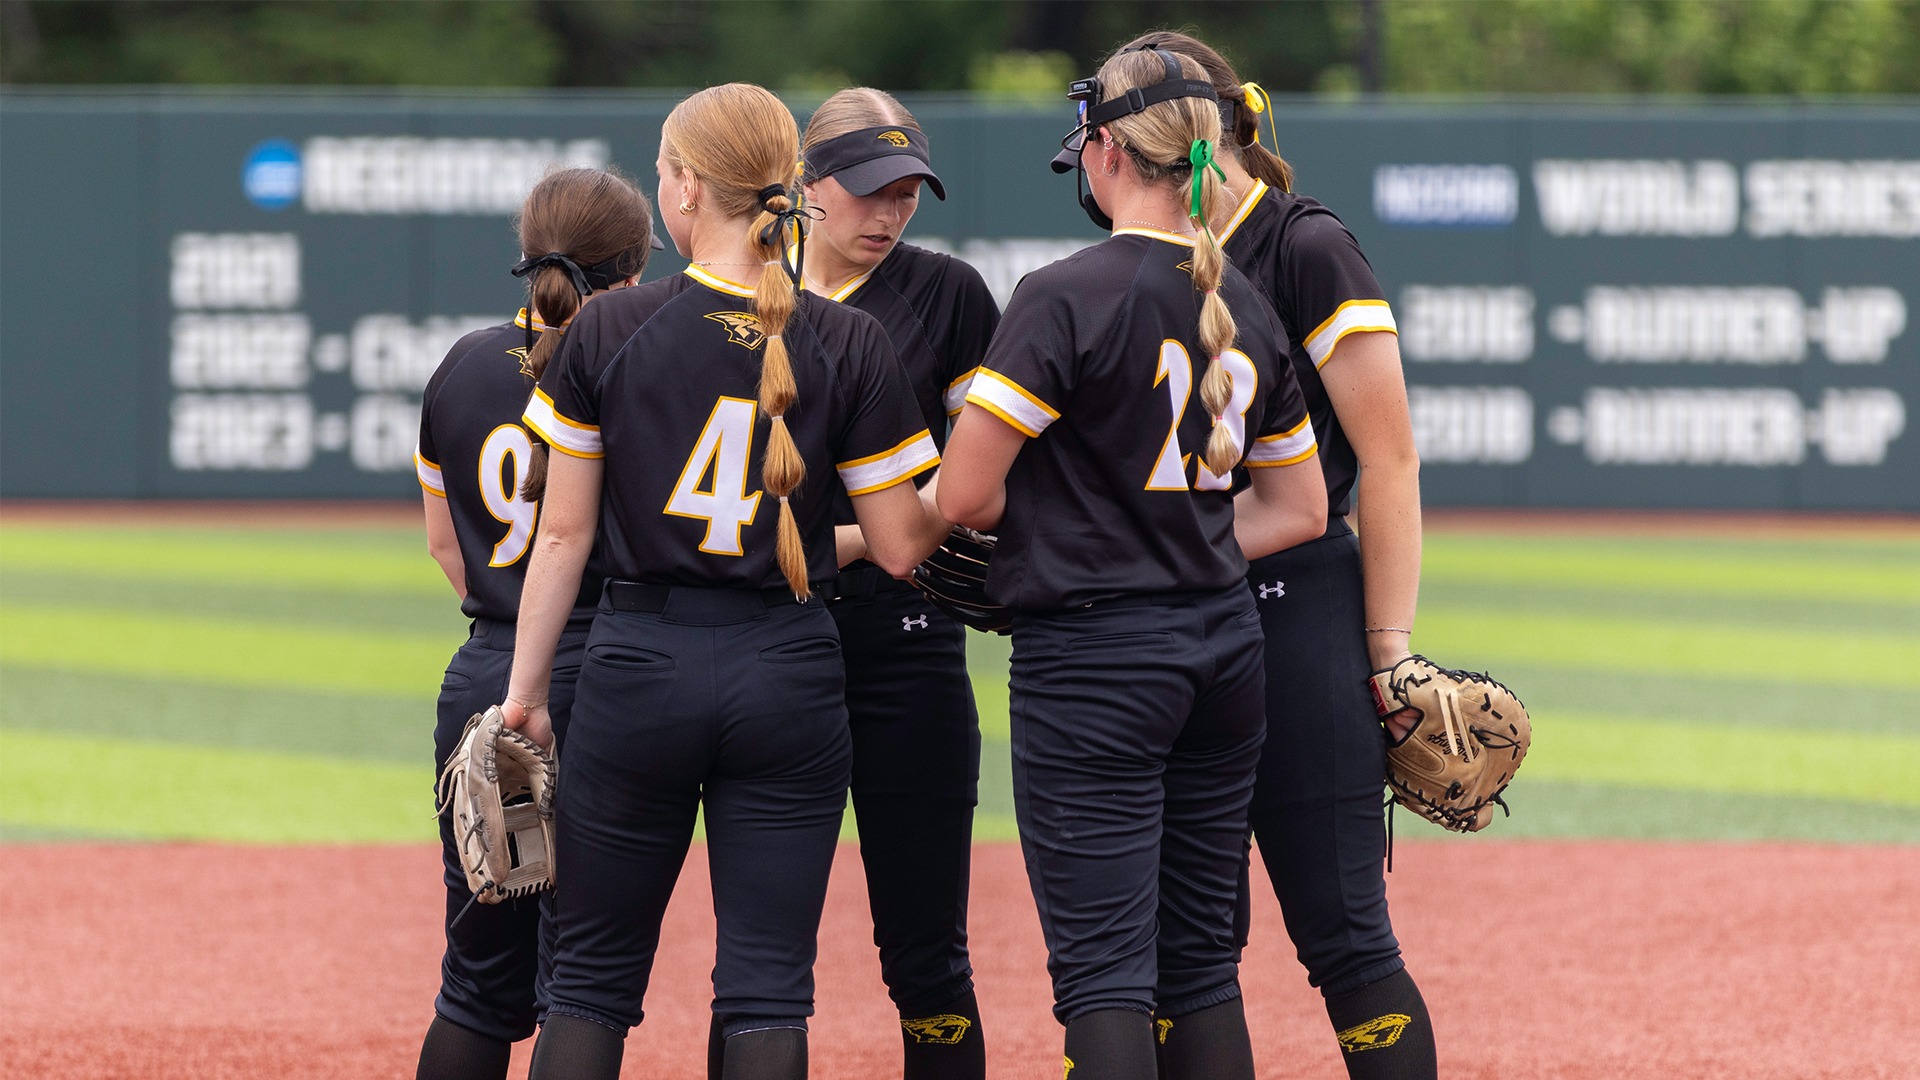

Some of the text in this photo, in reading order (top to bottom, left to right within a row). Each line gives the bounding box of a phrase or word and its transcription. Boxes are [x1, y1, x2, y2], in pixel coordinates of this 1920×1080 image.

[1533, 160, 1739, 236] WORLD
[1745, 160, 1920, 237] SERIES
[171, 313, 309, 388] 2022
[1402, 286, 1534, 363] 2016
[171, 393, 312, 470] 2023
[478, 423, 538, 567] 9
[663, 395, 763, 557] 4
